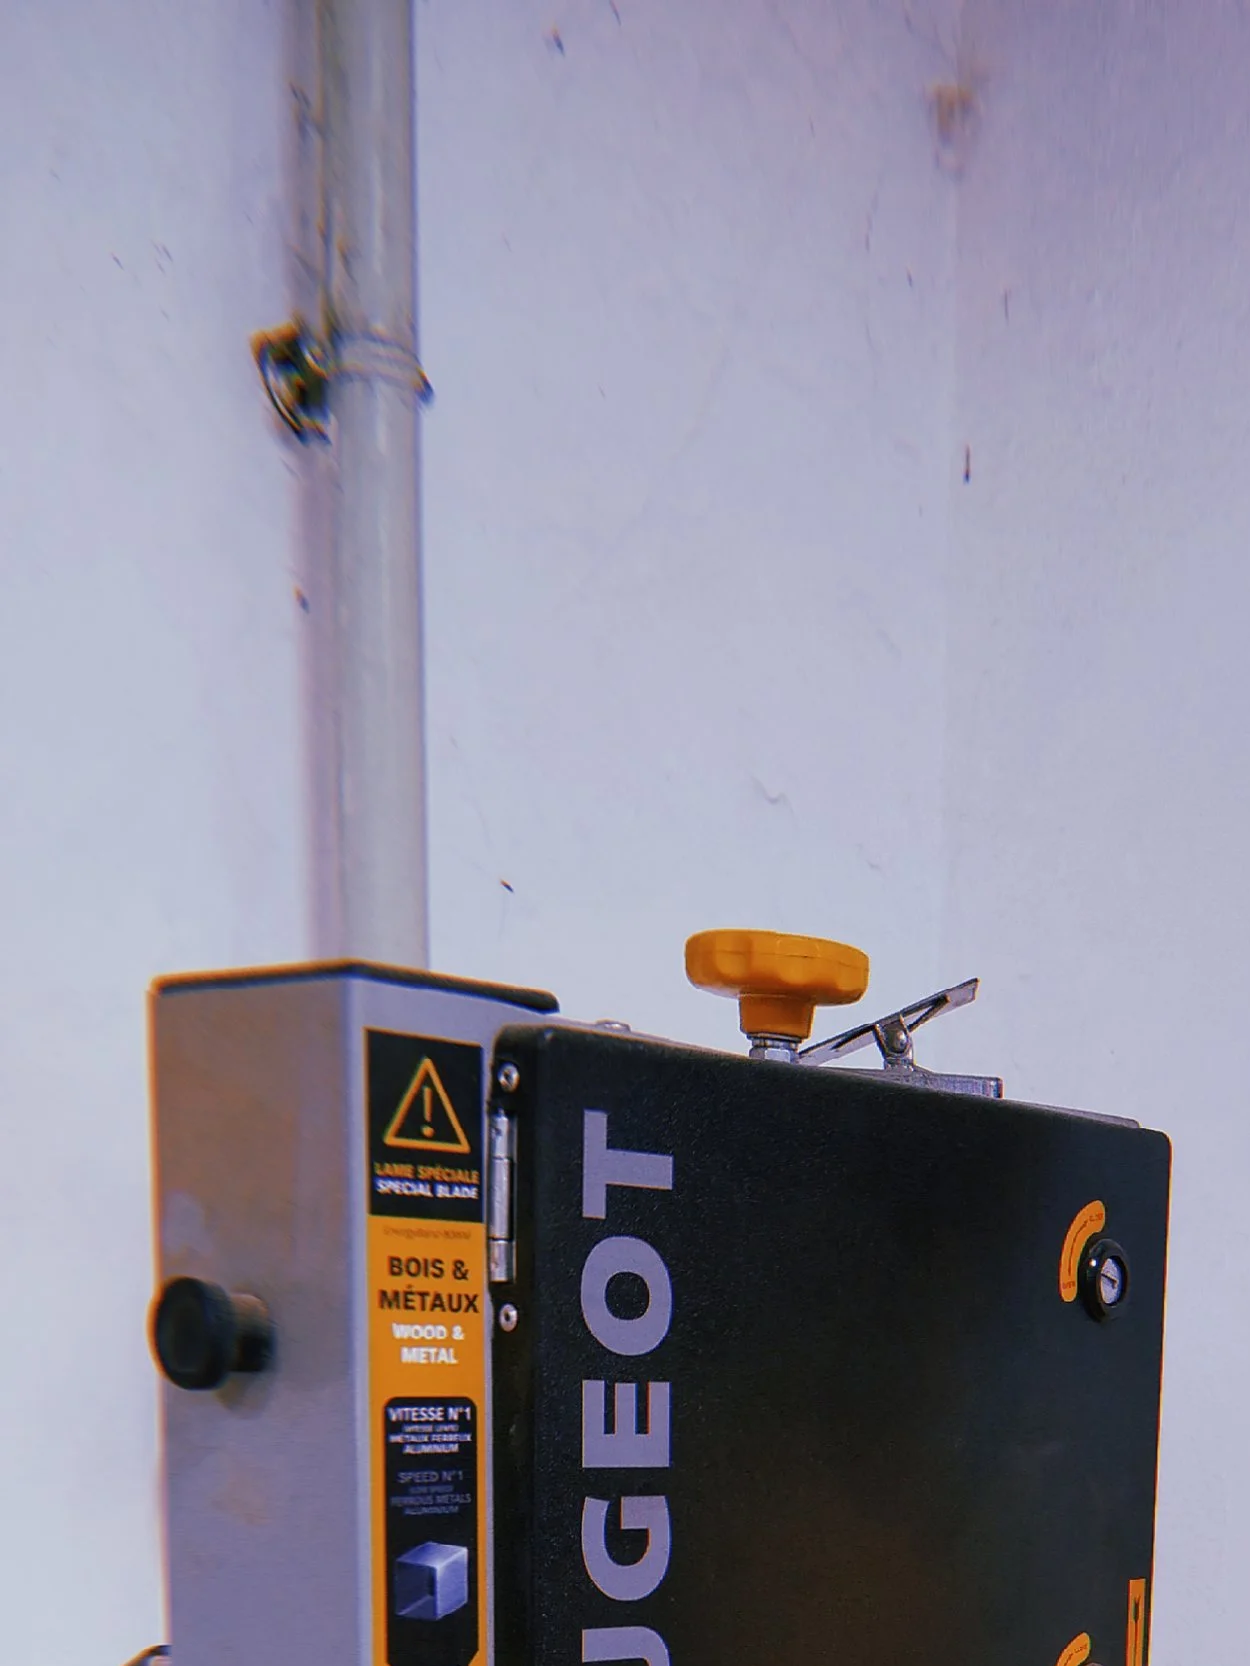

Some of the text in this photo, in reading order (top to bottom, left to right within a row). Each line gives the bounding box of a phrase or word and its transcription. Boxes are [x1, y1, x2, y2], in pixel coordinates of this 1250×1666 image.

[376, 1178, 479, 1199] SPECIAL BLADE
[388, 1256, 469, 1281] BOIS &
[378, 1284, 480, 1313] MÉTAUX
[392, 1323, 465, 1341] WOOD &
[400, 1346, 458, 1365] METAL
[387, 1407, 445, 1422] VITESSE
[398, 1471, 439, 1484] SPEED
